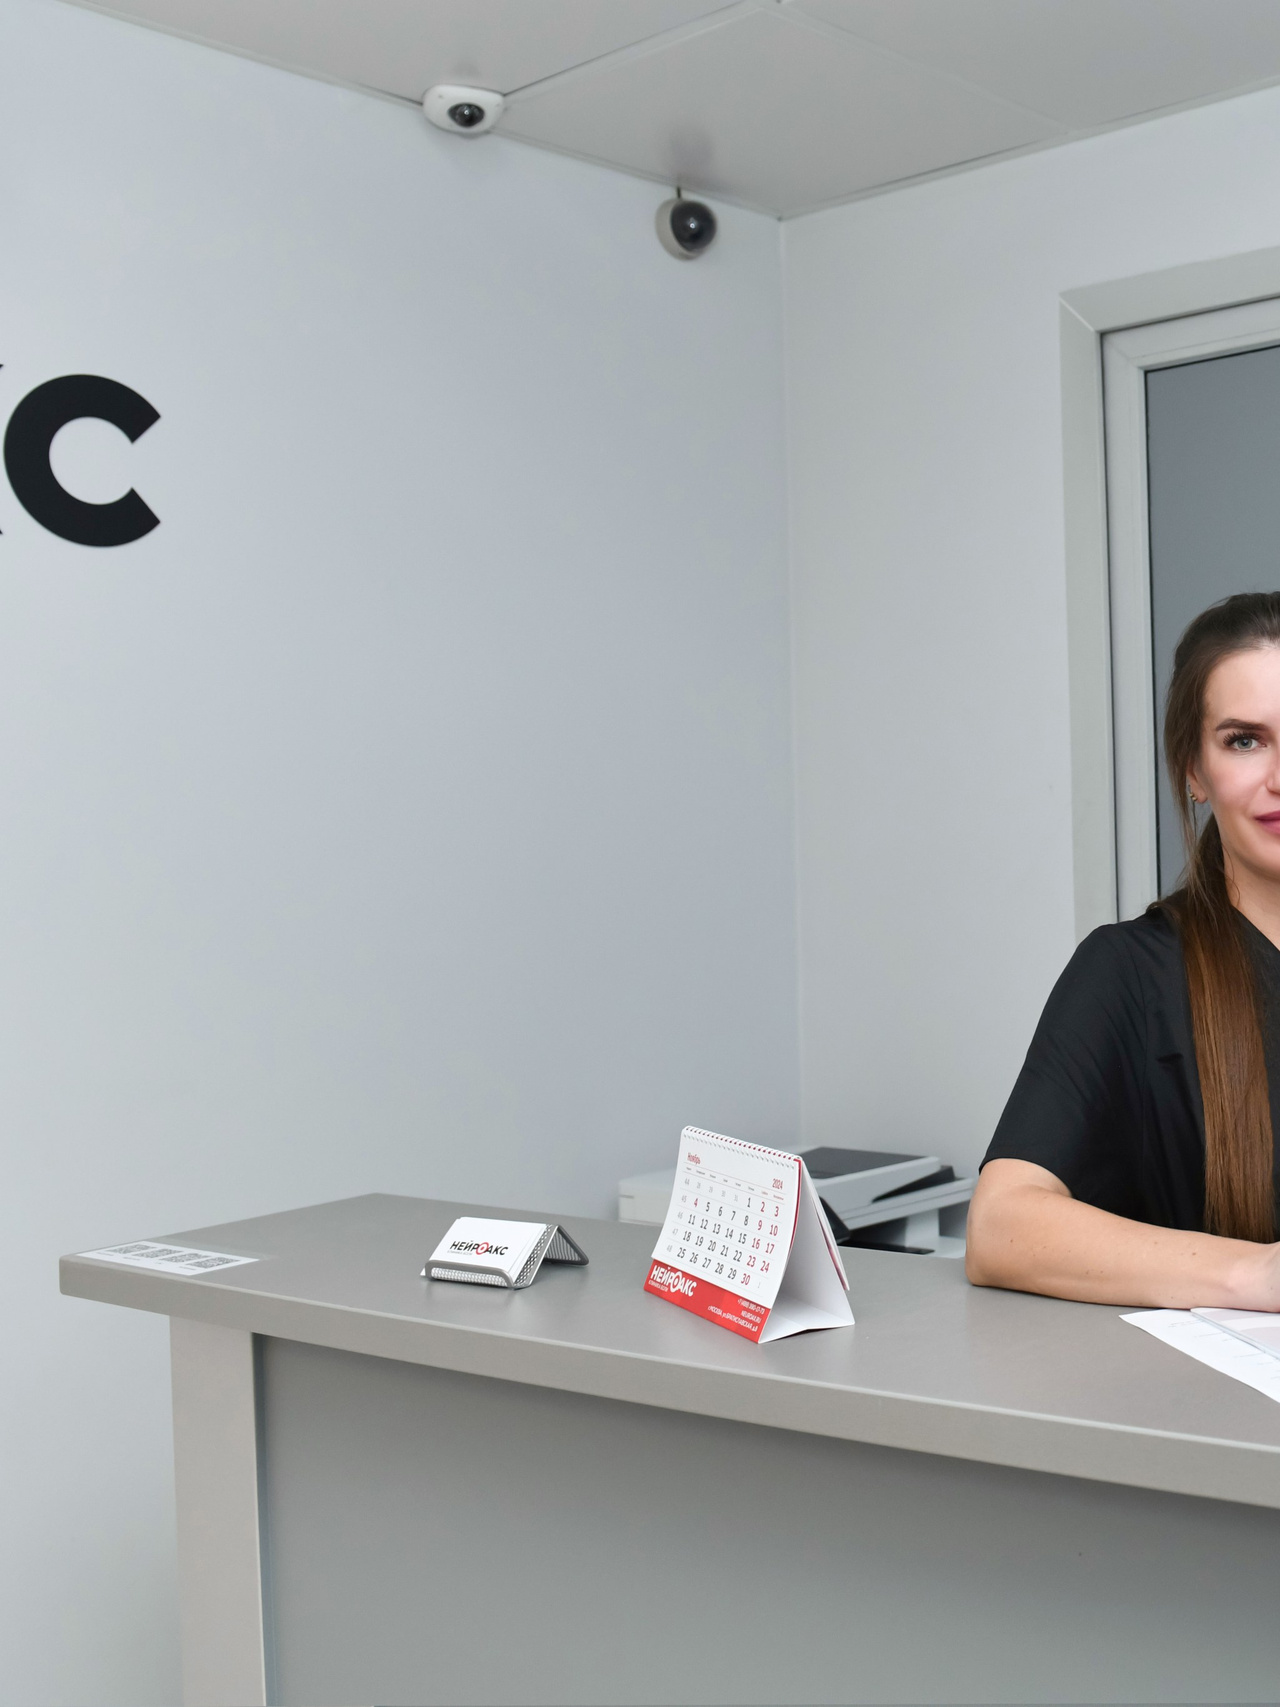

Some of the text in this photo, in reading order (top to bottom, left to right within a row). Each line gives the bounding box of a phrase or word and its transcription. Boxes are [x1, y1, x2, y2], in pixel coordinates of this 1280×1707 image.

[0, 364, 161, 547] С
[772, 1178, 784, 1190] 2024
[694, 1198, 698, 1207] 4
[705, 1202, 710, 1212] 5
[718, 1206, 723, 1217] 6
[731, 1210, 736, 1221] 7
[744, 1215, 749, 1226] 8
[757, 1220, 762, 1231] 9
[769, 1224, 778, 1236] 10
[747, 1197, 751, 1208] 1
[760, 1201, 765, 1213] 2
[774, 1206, 779, 1217] 3
[450, 1240, 509, 1256] НЕЙРОАКС
[683, 1231, 691, 1242] 18
[695, 1236, 704, 1247] 19
[707, 1240, 716, 1252] 20
[720, 1245, 729, 1257] 21
[733, 1250, 742, 1262] 22
[746, 1255, 756, 1268] 23
[760, 1260, 770, 1273] 24
[688, 1214, 696, 1225] 11
[700, 1219, 708, 1230] 12
[712, 1223, 721, 1235] 13
[725, 1228, 734, 1239] 14
[738, 1233, 747, 1244] 15
[751, 1238, 761, 1249] 16
[765, 1243, 775, 1254] 17
[650, 1265, 697, 1297] НЕЙРОАКС
[677, 1247, 686, 1259] 25
[689, 1252, 699, 1264] 26
[702, 1257, 711, 1268] 27
[715, 1262, 724, 1275] 28
[727, 1268, 737, 1280] 29
[741, 1273, 751, 1285] 30
